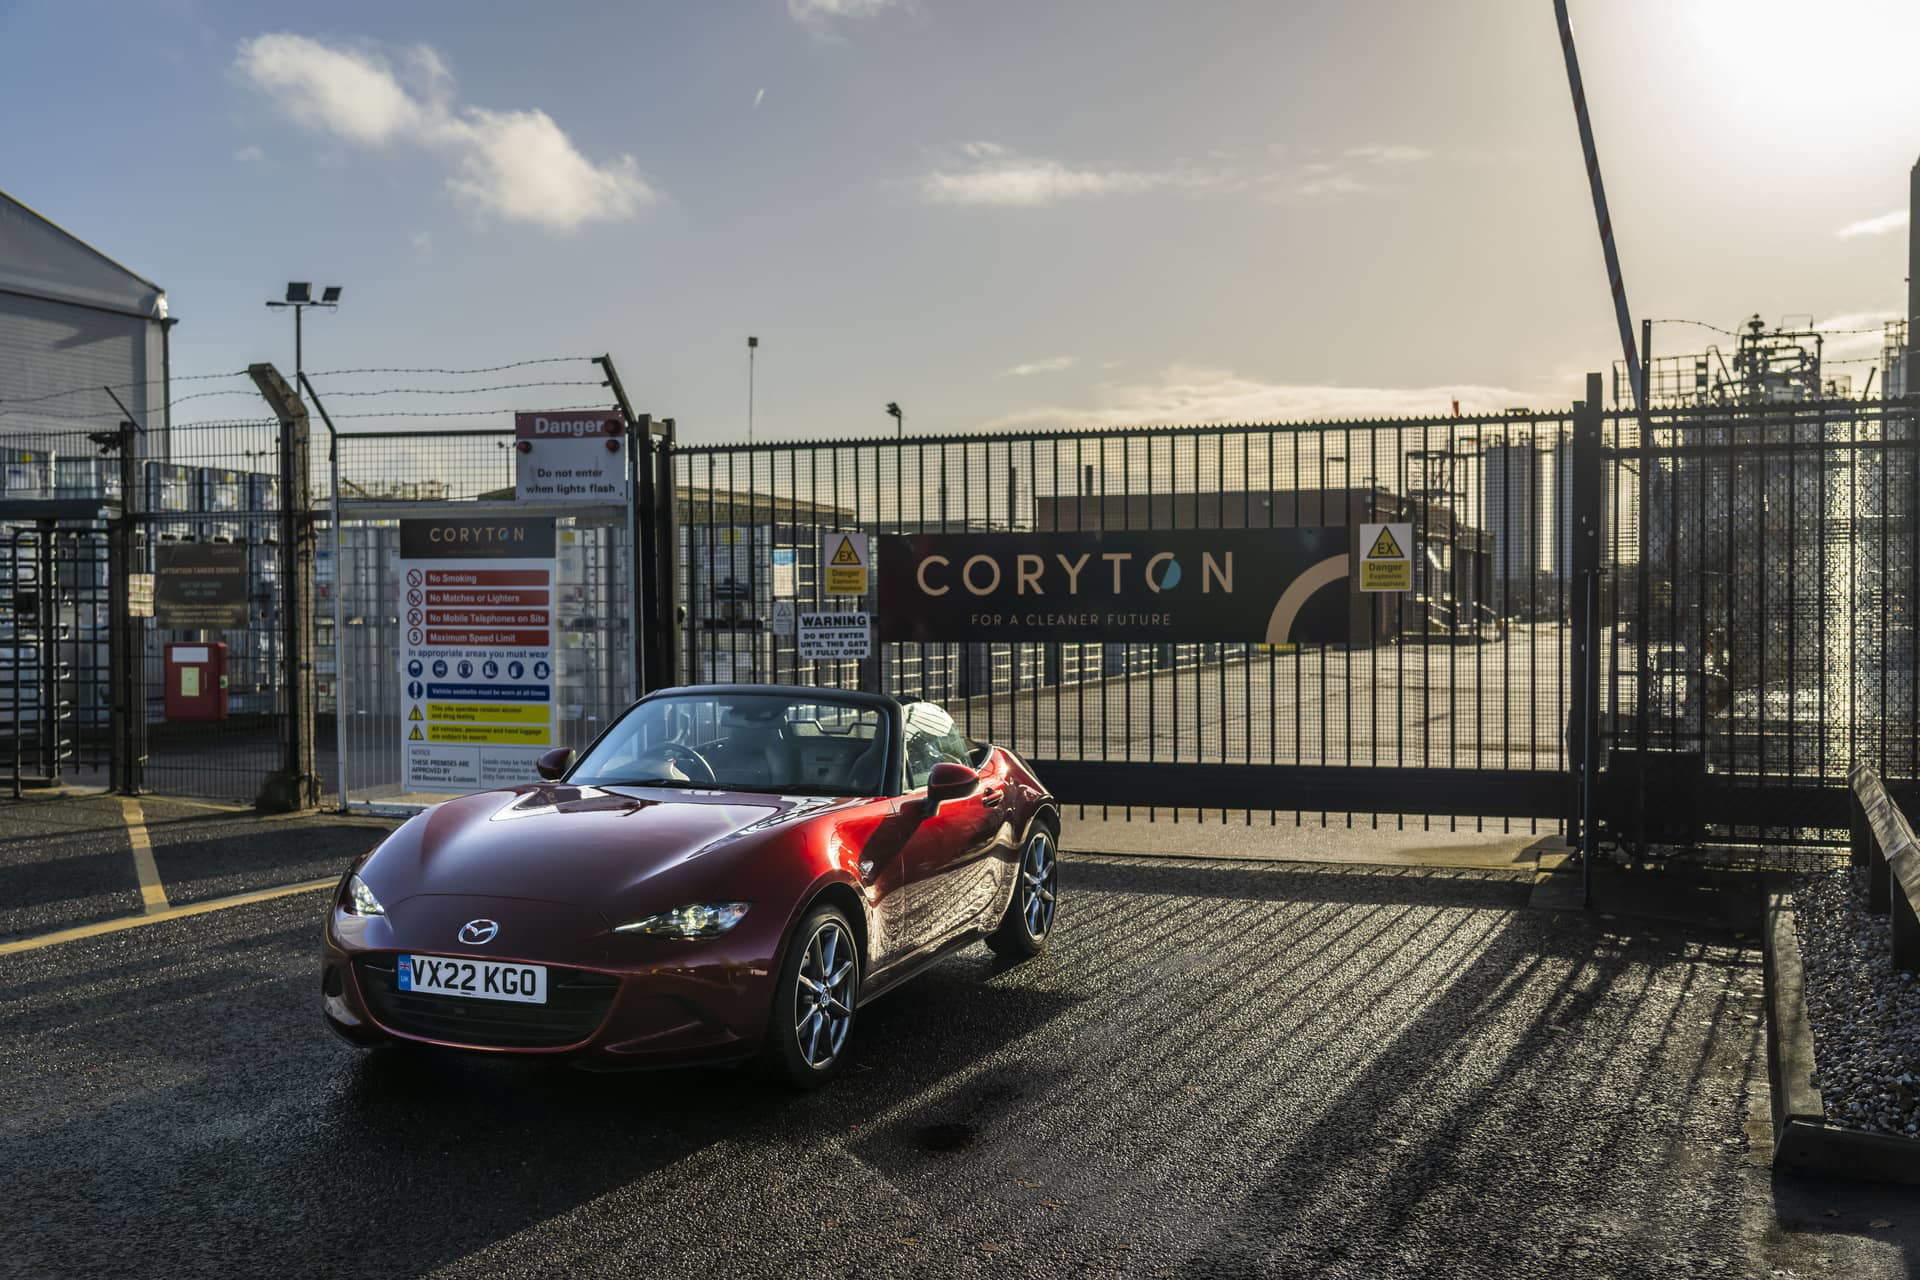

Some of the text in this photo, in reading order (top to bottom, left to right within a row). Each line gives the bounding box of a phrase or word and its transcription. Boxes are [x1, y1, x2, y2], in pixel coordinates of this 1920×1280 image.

[535, 417, 604, 436] Danger
[538, 469, 603, 478] Do not enter
[526, 484, 615, 495] when lights flash
[429, 527, 525, 542] CORYTON
[1377, 543, 1394, 554] EX
[840, 551, 852, 560] EX
[1368, 563, 1402, 573] Danger
[832, 570, 860, 578] Danger
[917, 551, 1233, 596] CORYTON
[430, 574, 477, 584] No Smoking
[443, 594, 474, 602] Matches
[487, 594, 520, 604] Lighters
[430, 614, 441, 622] No
[443, 614, 468, 622] Mobile
[471, 614, 516, 624] Telephones
[530, 614, 545, 622] Site
[802, 615, 867, 626] WARNING
[971, 614, 1171, 626] FOR A CLEANER FUTURE
[430, 634, 516, 643] Maximum Speed Limit
[408, 649, 416, 657] In
[418, 649, 463, 659] appropriate
[488, 651, 504, 659] you
[506, 650, 527, 658] must
[520, 728, 542, 736] luggage
[430, 759, 457, 767] PREMISES
[423, 774, 447, 782] Revenue
[453, 775, 477, 783] Customs
[400, 974, 409, 983] UK
[411, 958, 536, 996] VX22 KGO
